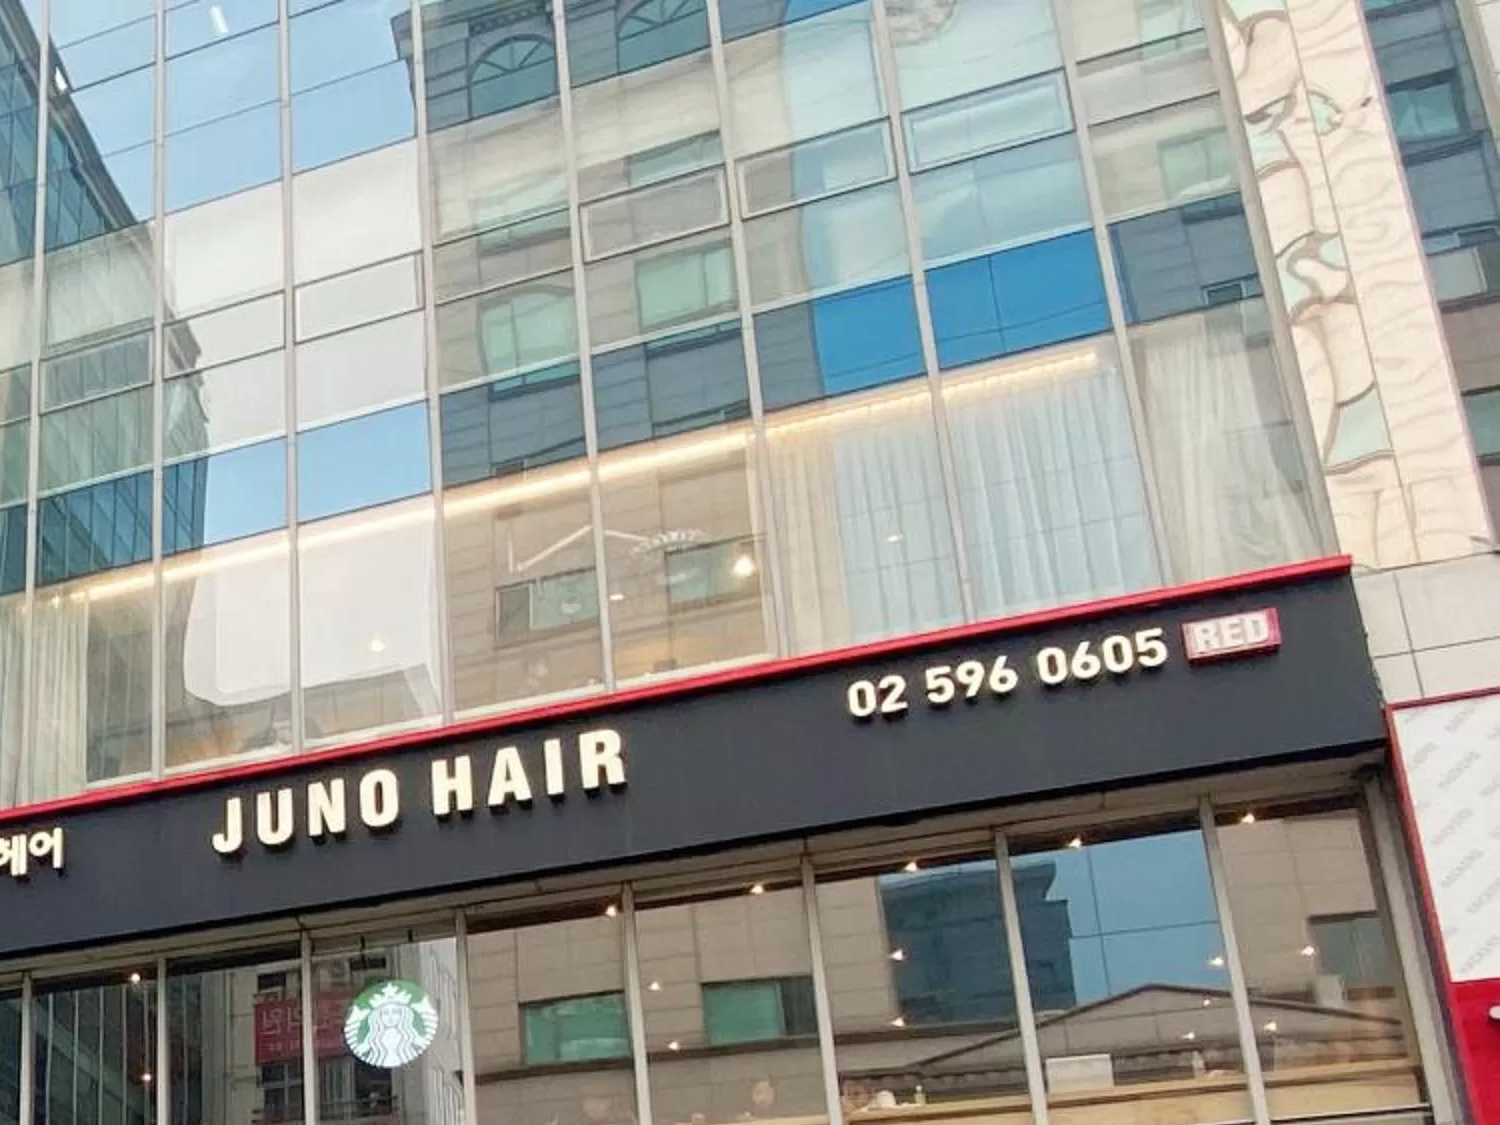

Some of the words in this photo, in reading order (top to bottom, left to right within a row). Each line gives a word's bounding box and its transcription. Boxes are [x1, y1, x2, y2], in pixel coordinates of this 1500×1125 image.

[847, 674, 909, 718] 02
[925, 655, 1019, 706] 596
[1036, 628, 1169, 687] 0605
[1190, 611, 1272, 656] RED
[212, 768, 399, 855] JUNO
[431, 728, 628, 817] HAIR
